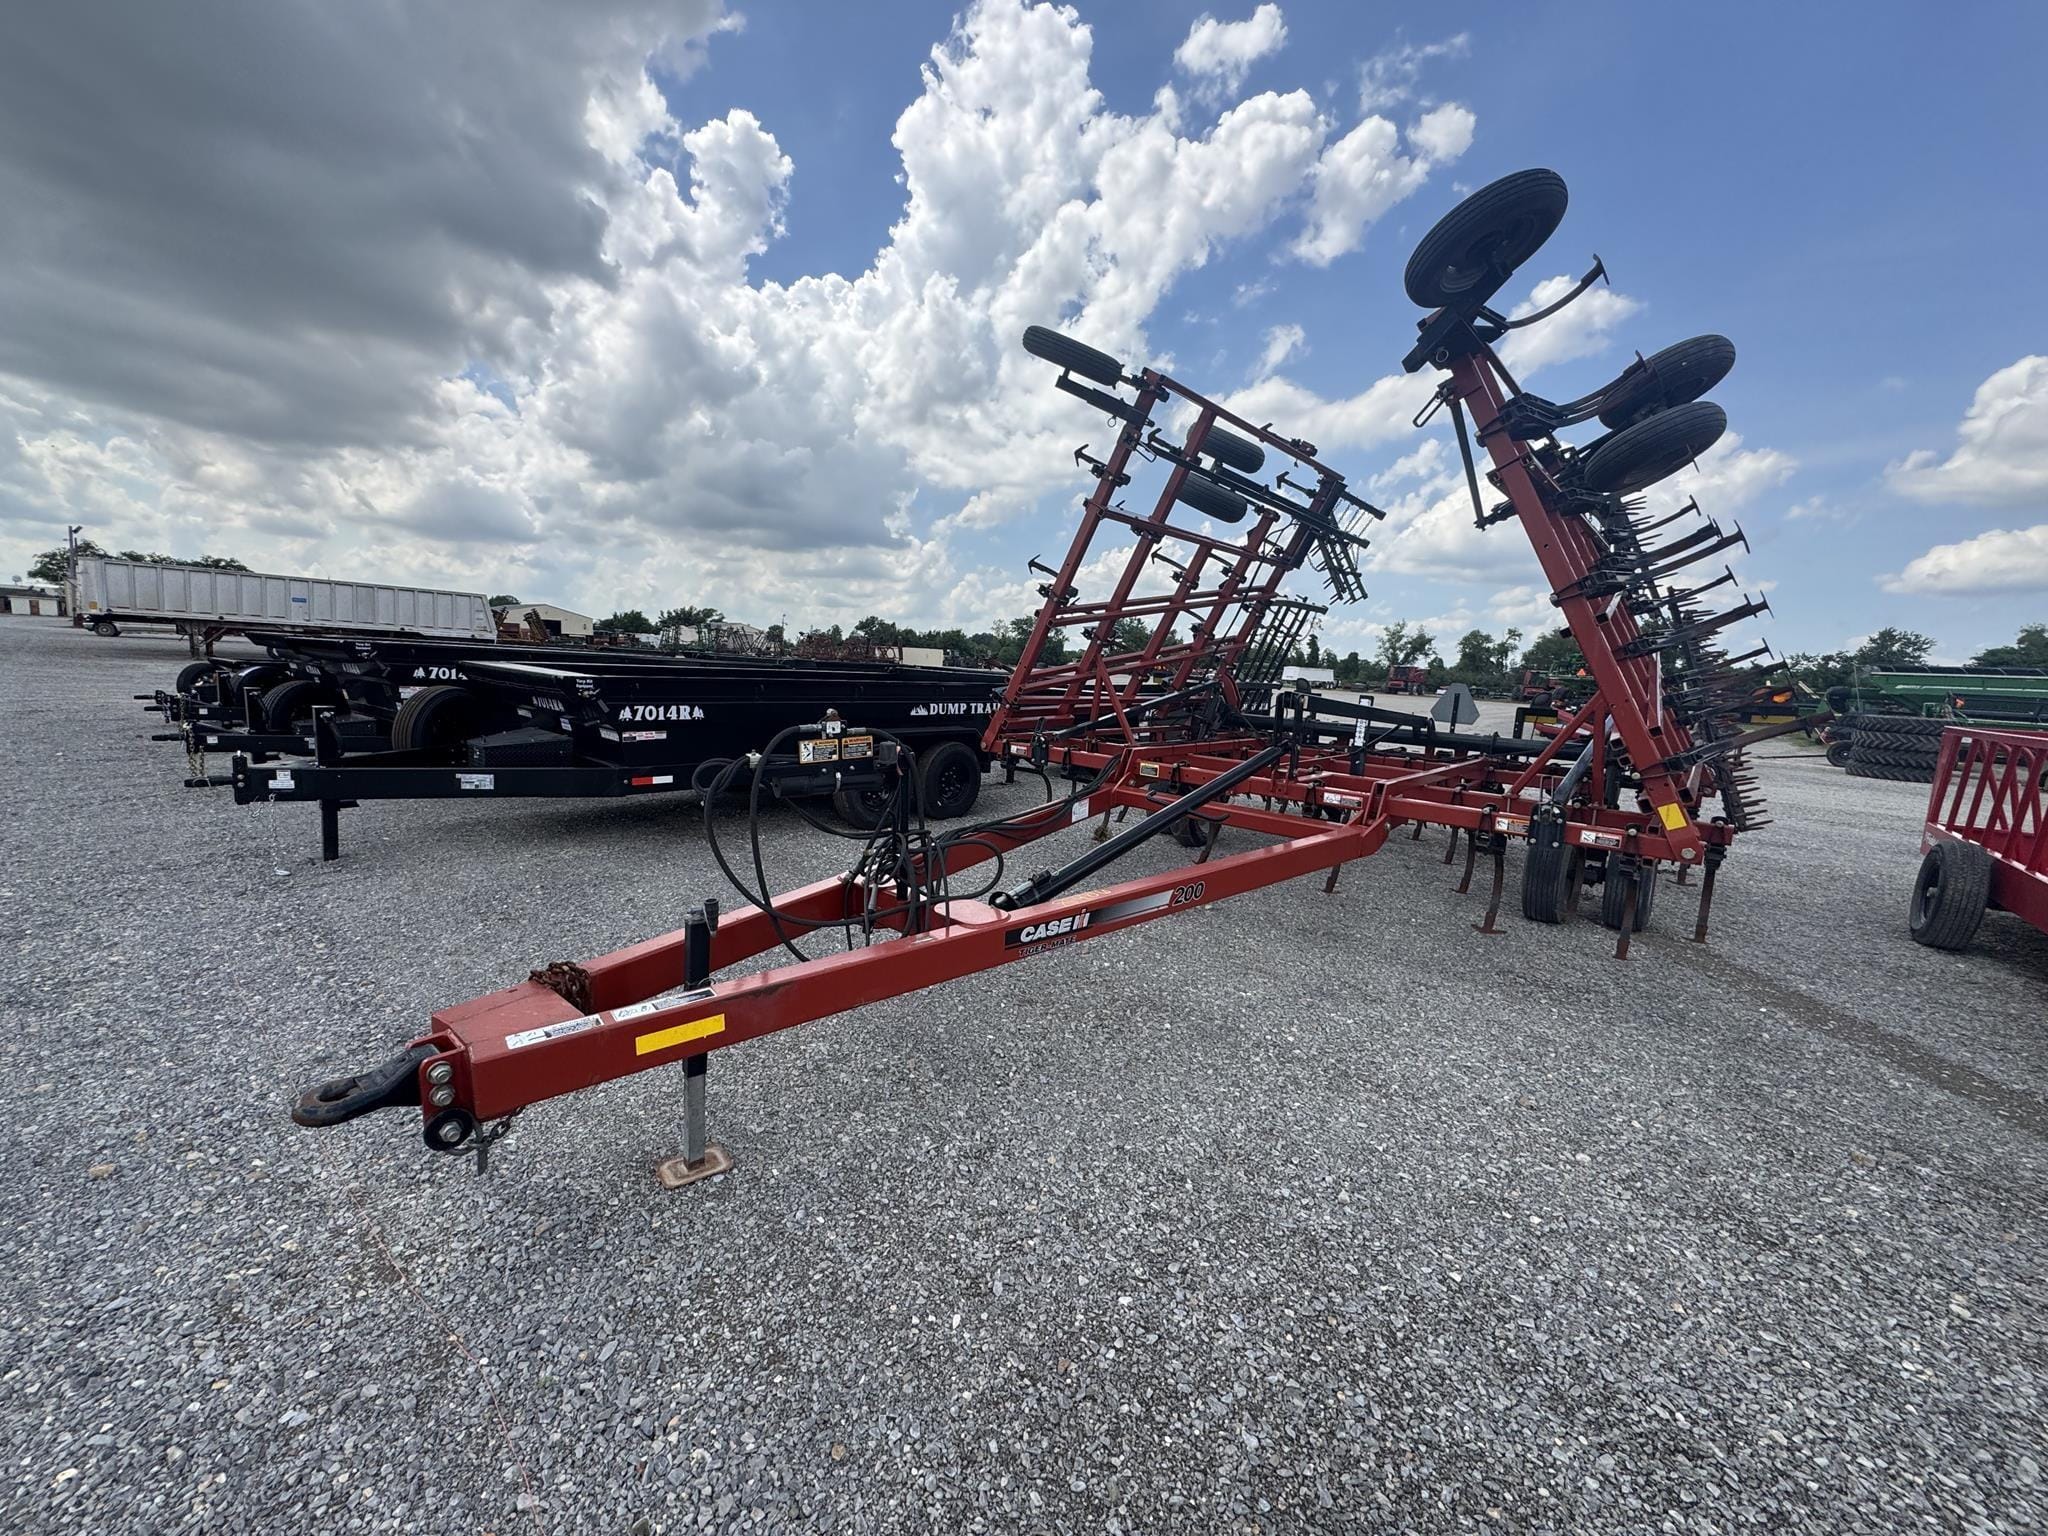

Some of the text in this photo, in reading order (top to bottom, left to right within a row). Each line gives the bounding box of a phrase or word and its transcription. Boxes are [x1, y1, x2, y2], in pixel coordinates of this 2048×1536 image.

[633, 705, 692, 721] 7014R
[929, 703, 967, 715] DUMP
[1172, 882, 1205, 907] 200
